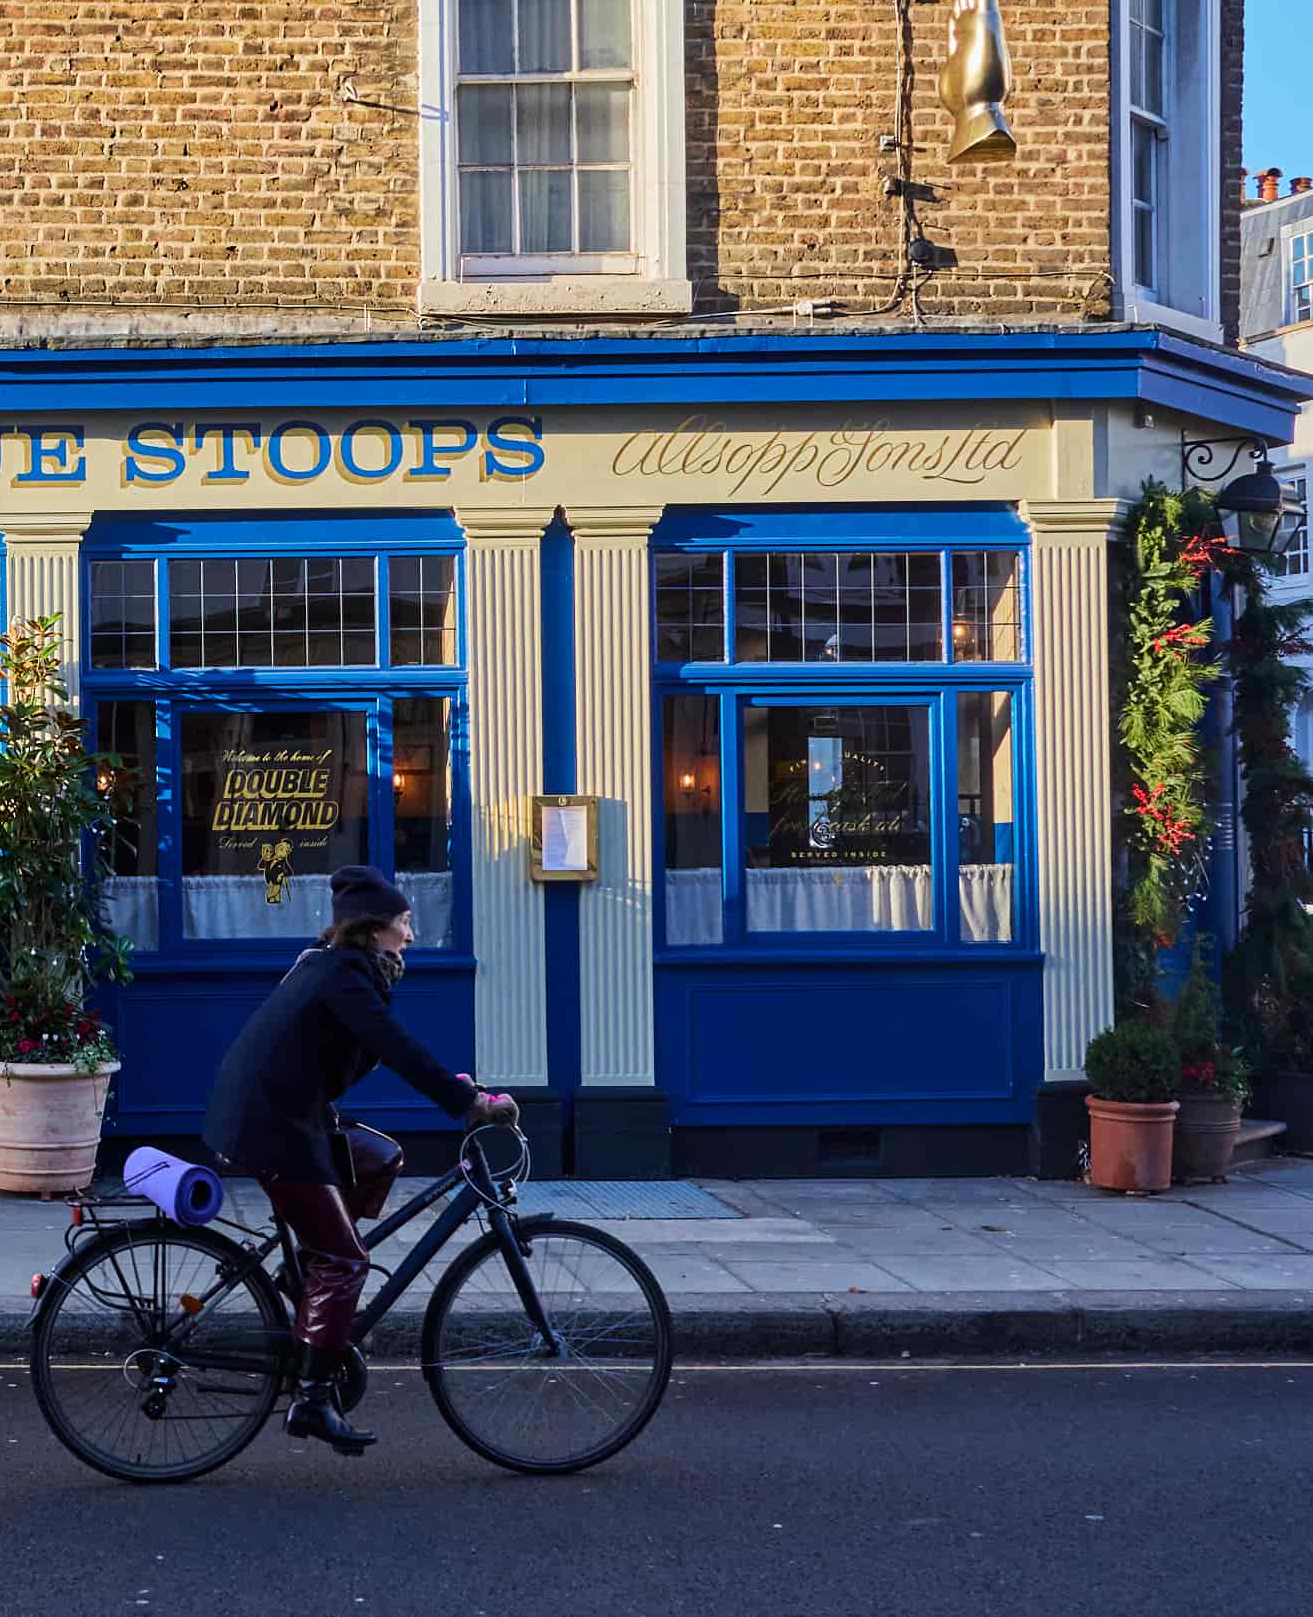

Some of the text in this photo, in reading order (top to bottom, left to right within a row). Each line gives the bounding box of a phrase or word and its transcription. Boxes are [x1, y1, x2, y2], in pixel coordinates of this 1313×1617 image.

[120, 415, 546, 489] STOOPS
[612, 414, 819, 497] Allsopp
[816, 416, 948, 486] Sons
[921, 420, 1026, 484] Ltd
[273, 749, 289, 762] the
[316, 749, 334, 765] of
[223, 768, 331, 799] DOUBLE
[212, 800, 339, 831] DIAMOND
[790, 849, 887, 860] SERVED INSIDE
